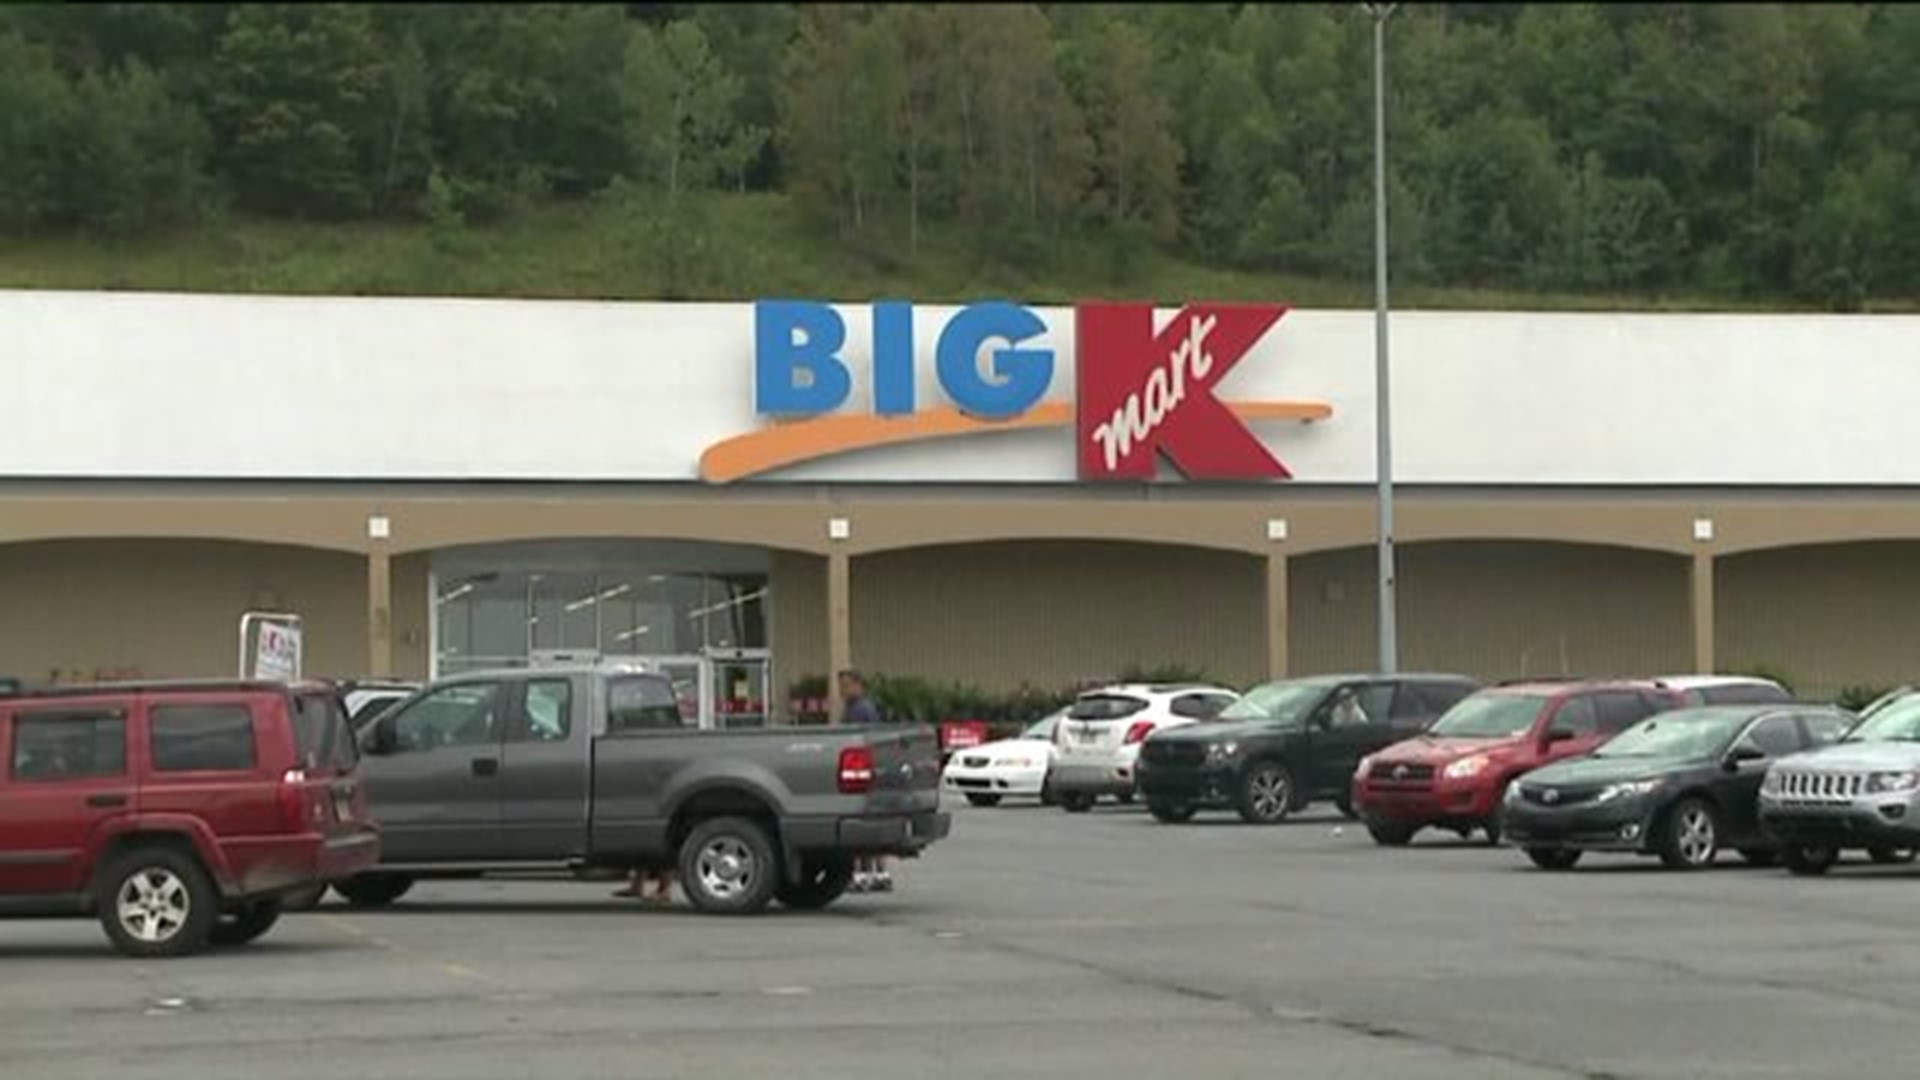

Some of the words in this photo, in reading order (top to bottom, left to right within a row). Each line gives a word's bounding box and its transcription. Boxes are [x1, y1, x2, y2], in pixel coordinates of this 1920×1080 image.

[755, 299, 1055, 418] BIG
[1075, 303, 1292, 480] K
[1093, 313, 1215, 470] mart
